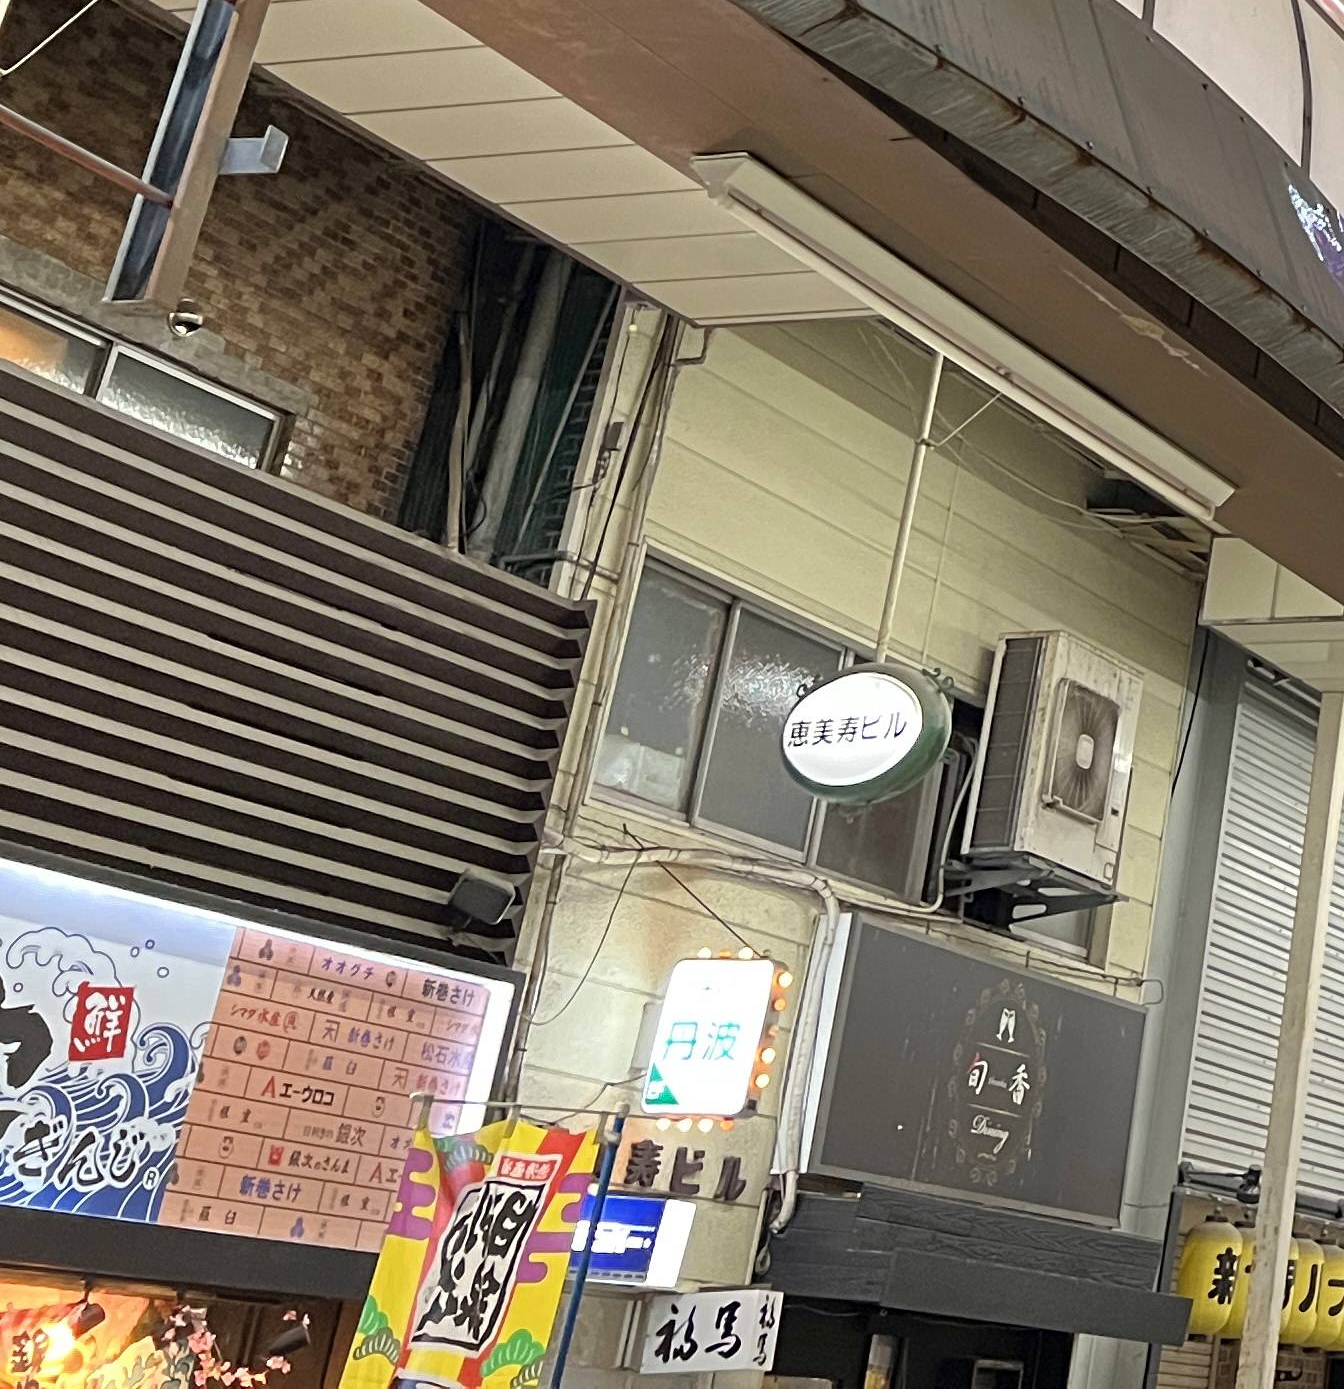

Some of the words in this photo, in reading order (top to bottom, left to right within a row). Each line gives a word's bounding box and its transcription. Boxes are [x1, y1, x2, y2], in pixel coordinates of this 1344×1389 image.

[787, 712, 908, 748] 恵美寿ビル
[73, 991, 127, 1052] 鮮
[662, 1021, 741, 1061] 丹波
[12, 1119, 145, 1187] ぎんじ
[970, 1114, 1010, 1155] Dining
